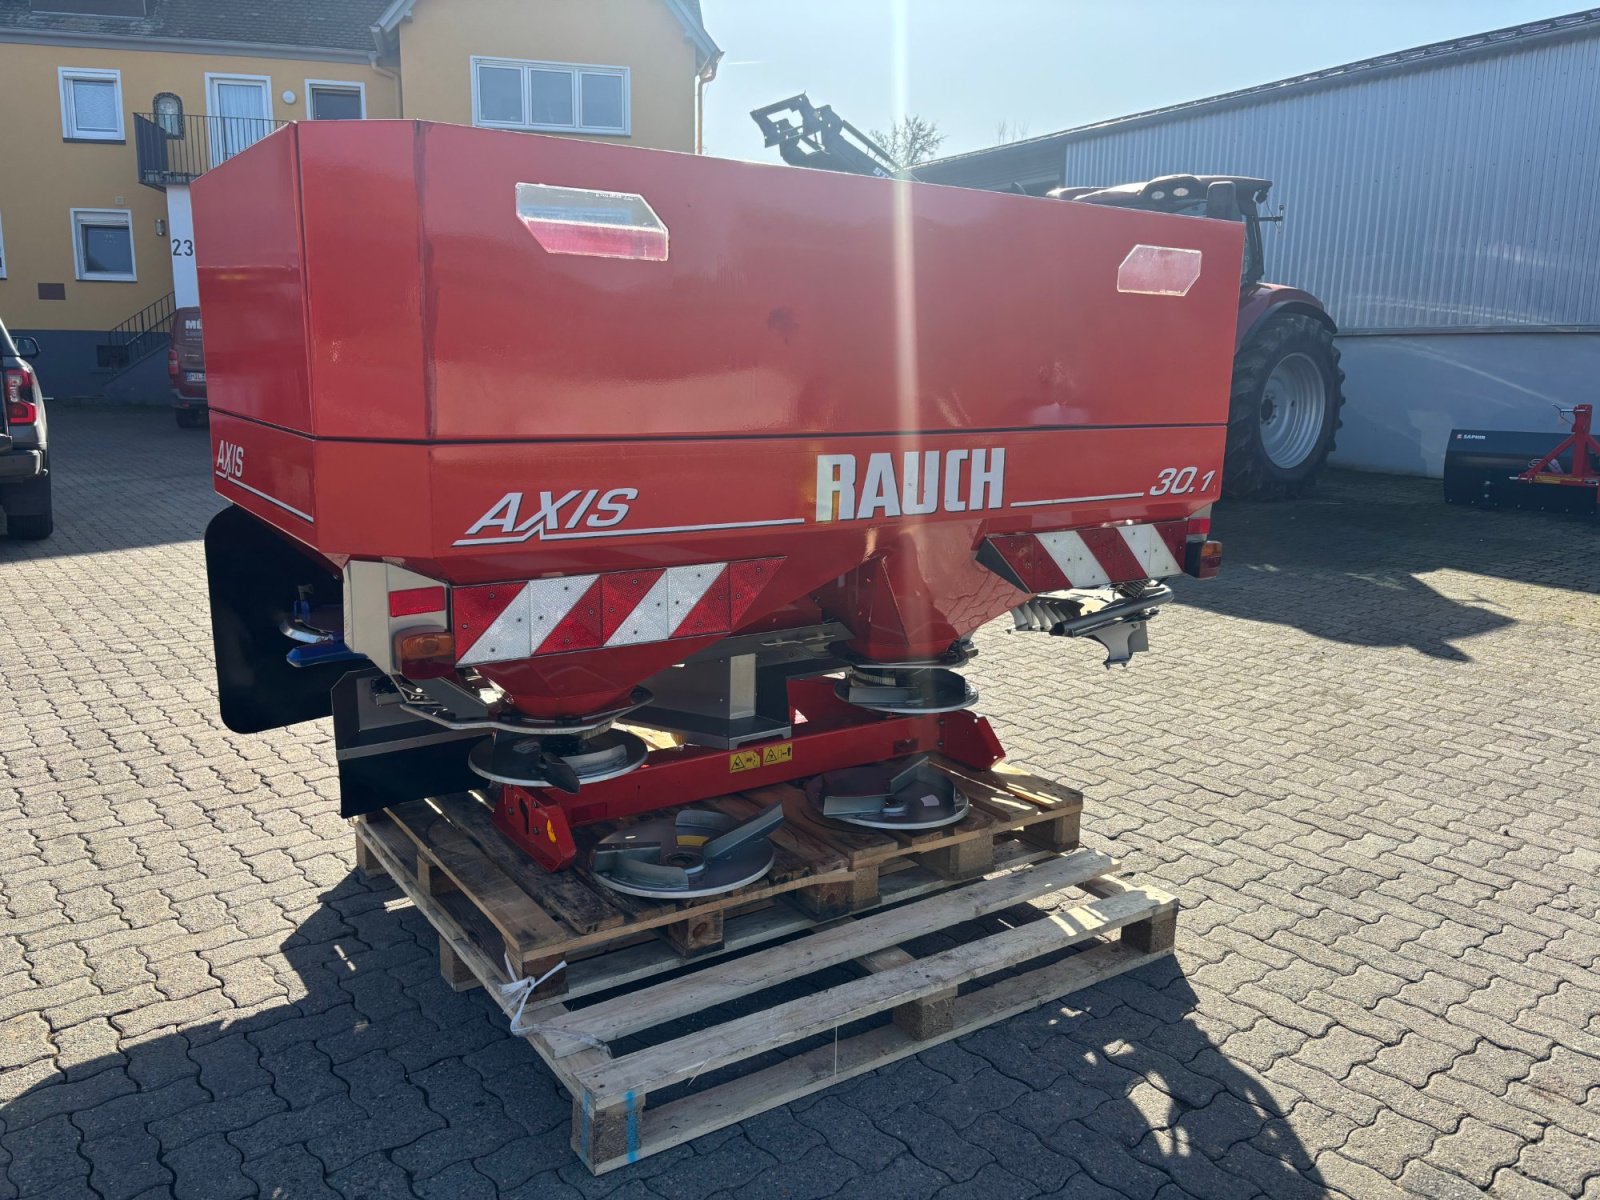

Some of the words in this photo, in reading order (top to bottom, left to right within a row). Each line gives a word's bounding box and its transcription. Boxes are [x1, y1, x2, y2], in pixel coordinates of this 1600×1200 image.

[172, 238, 194, 256] 23
[216, 439, 244, 478] AXIS
[815, 447, 1006, 523] RAUCH
[1149, 466, 1216, 496] 30.1
[464, 487, 640, 536] AXIS
